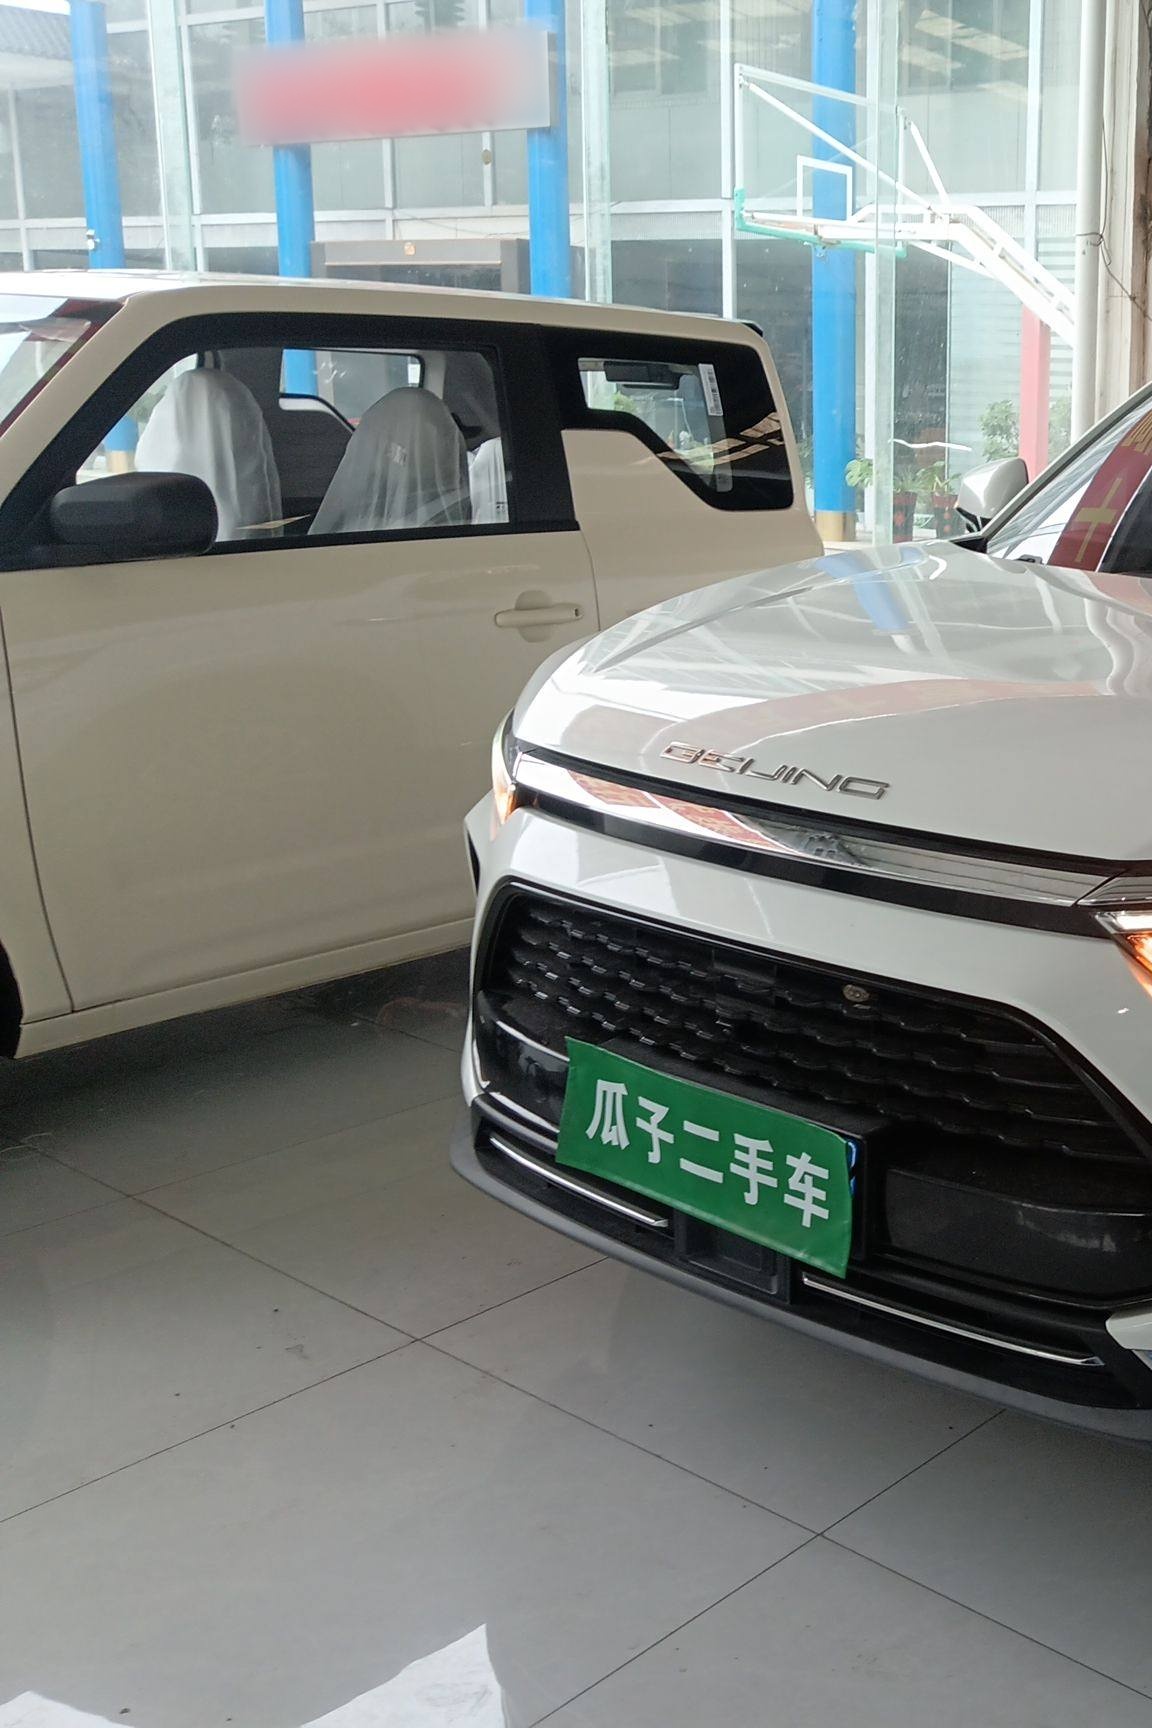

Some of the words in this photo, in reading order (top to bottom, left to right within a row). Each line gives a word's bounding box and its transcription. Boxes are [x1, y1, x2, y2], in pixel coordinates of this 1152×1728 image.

[660, 741, 890, 800] BEIJING
[585, 1079, 830, 1228] 瓜子二手车
